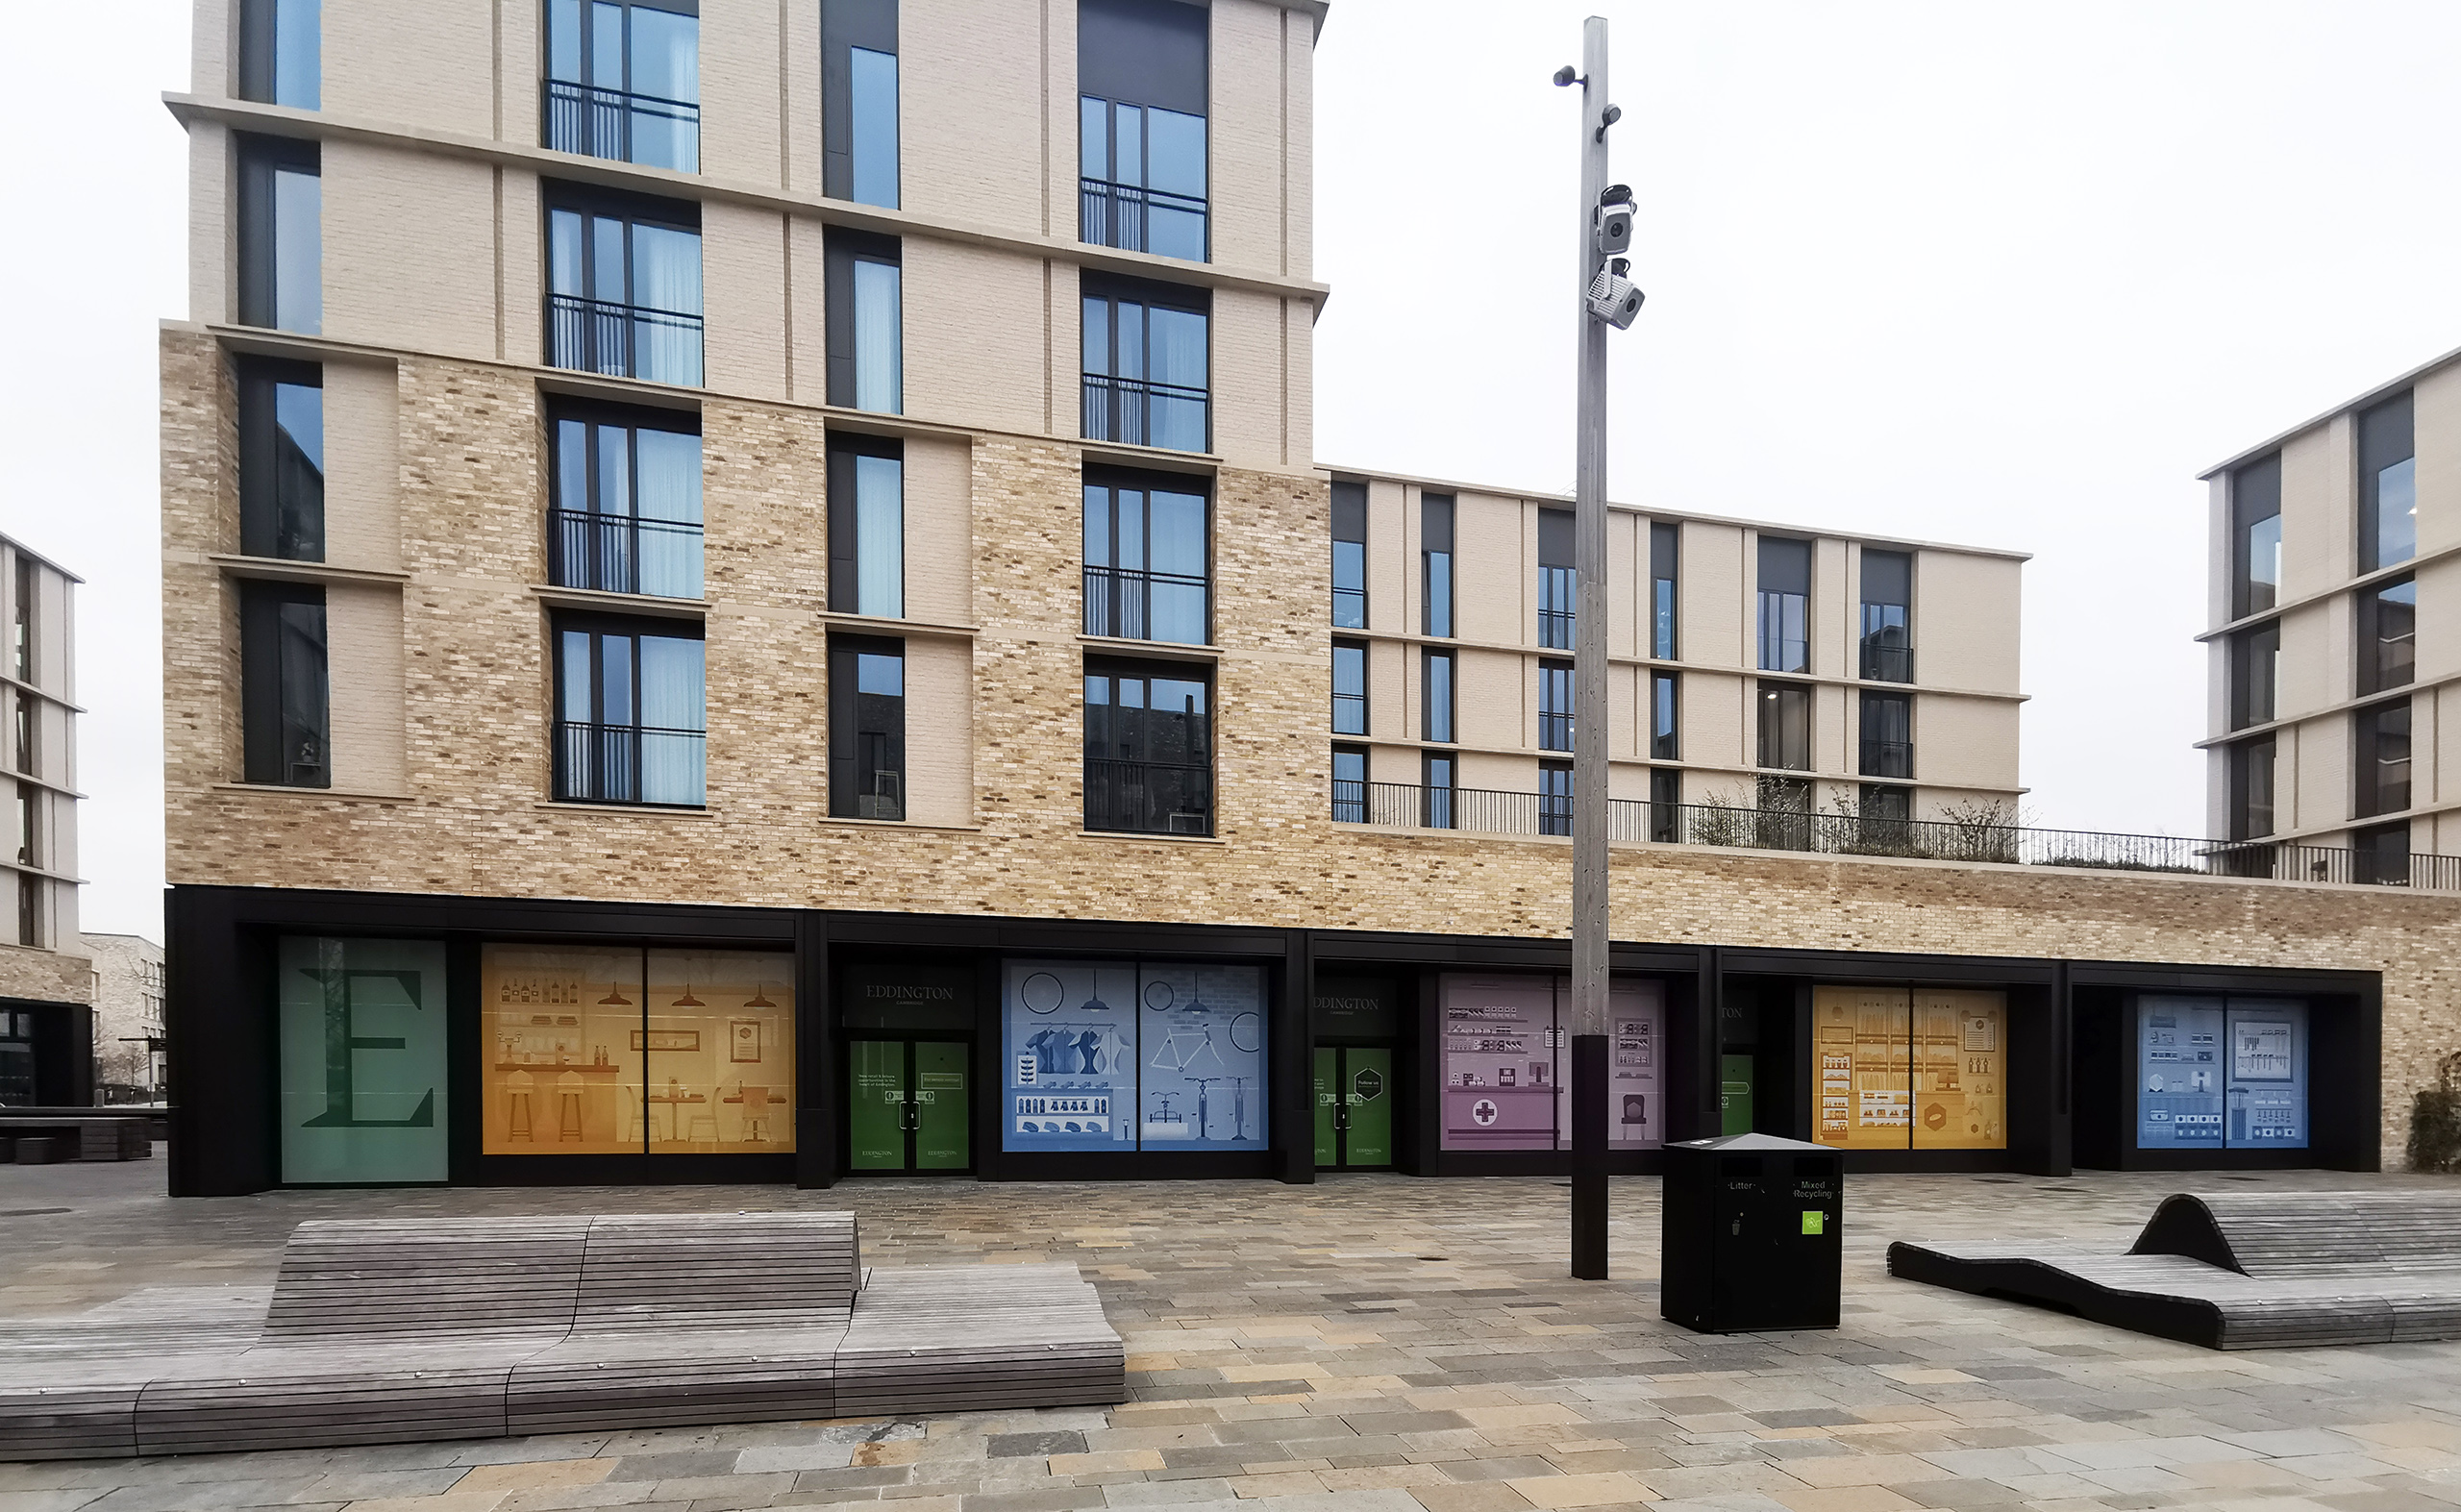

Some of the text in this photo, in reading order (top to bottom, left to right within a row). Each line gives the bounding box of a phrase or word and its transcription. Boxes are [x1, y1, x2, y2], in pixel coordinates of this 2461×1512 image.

[866, 985, 954, 1000] EDDINGTON
[1313, 997, 1380, 1010] DDINGTON
[297, 968, 435, 1128] E
[1729, 1181, 1753, 1190] Litter
[1802, 1180, 1826, 1189] Mixed
[1794, 1190, 1832, 1200] Recycling
